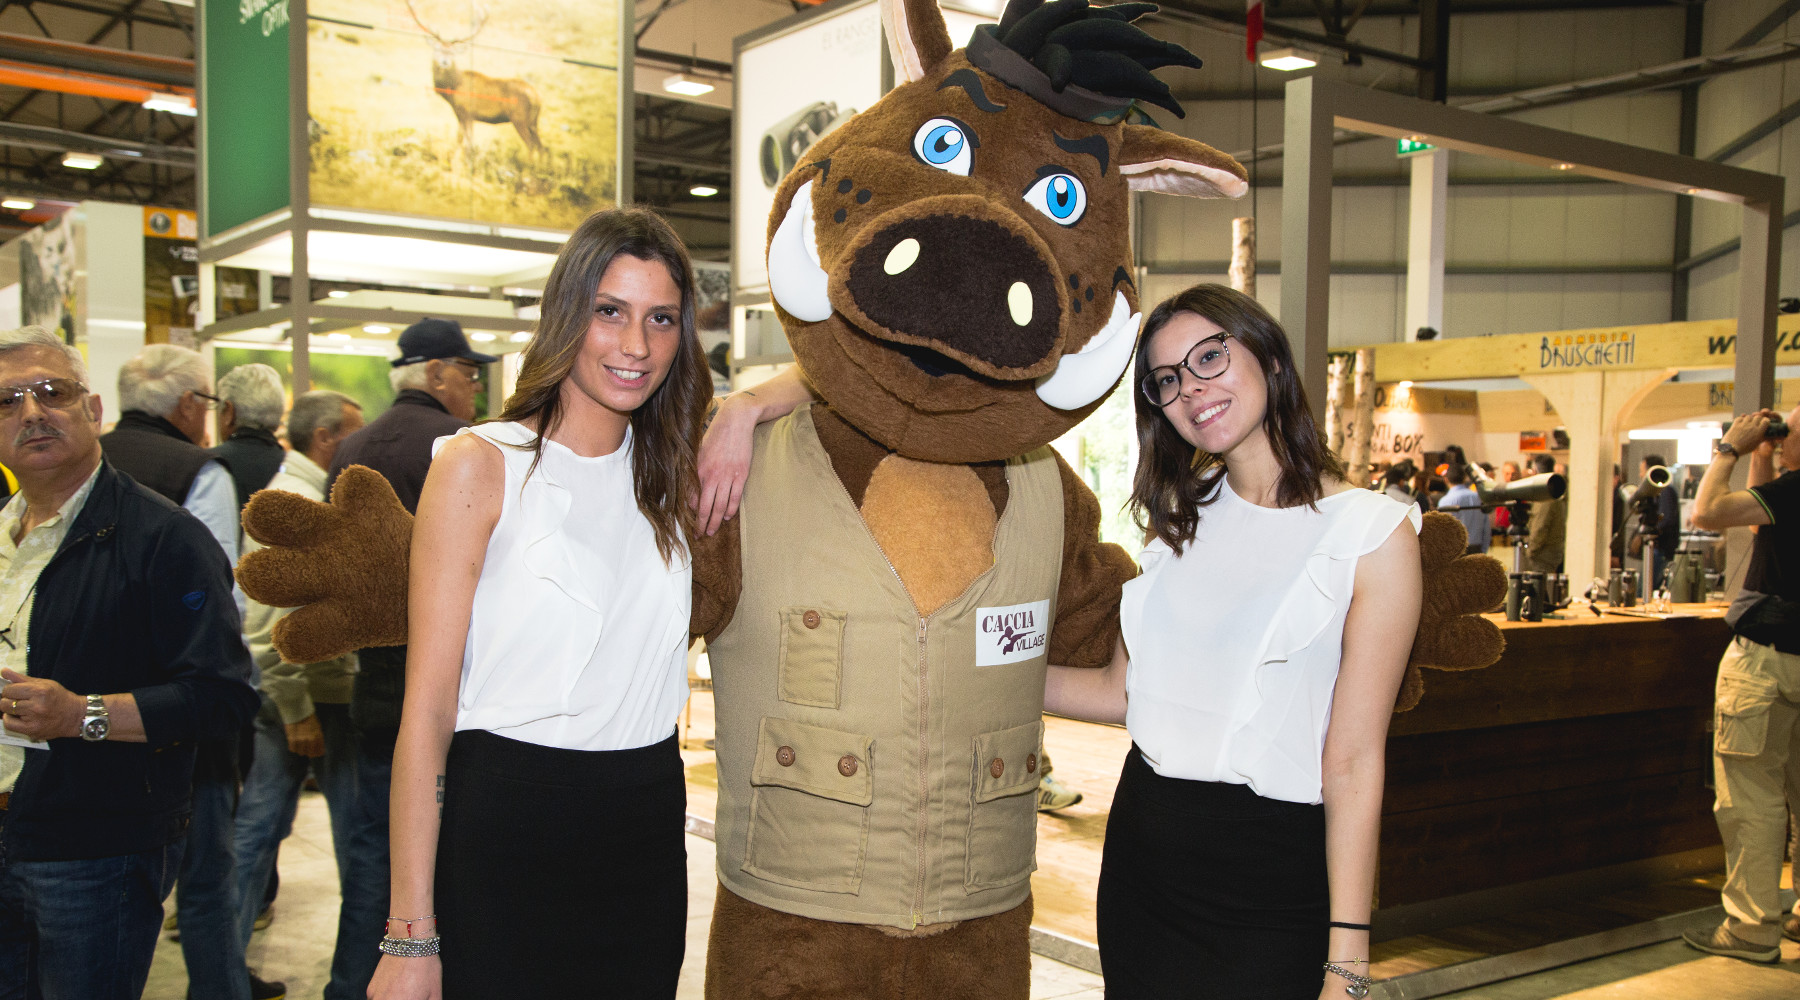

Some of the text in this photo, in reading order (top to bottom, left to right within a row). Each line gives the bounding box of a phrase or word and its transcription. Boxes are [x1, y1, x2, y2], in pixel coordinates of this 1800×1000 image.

[1540, 333, 1635, 368] BRUSCHETTI
[982, 610, 1035, 633] CACCIA
[1016, 633, 1045, 652] VILLAGE
